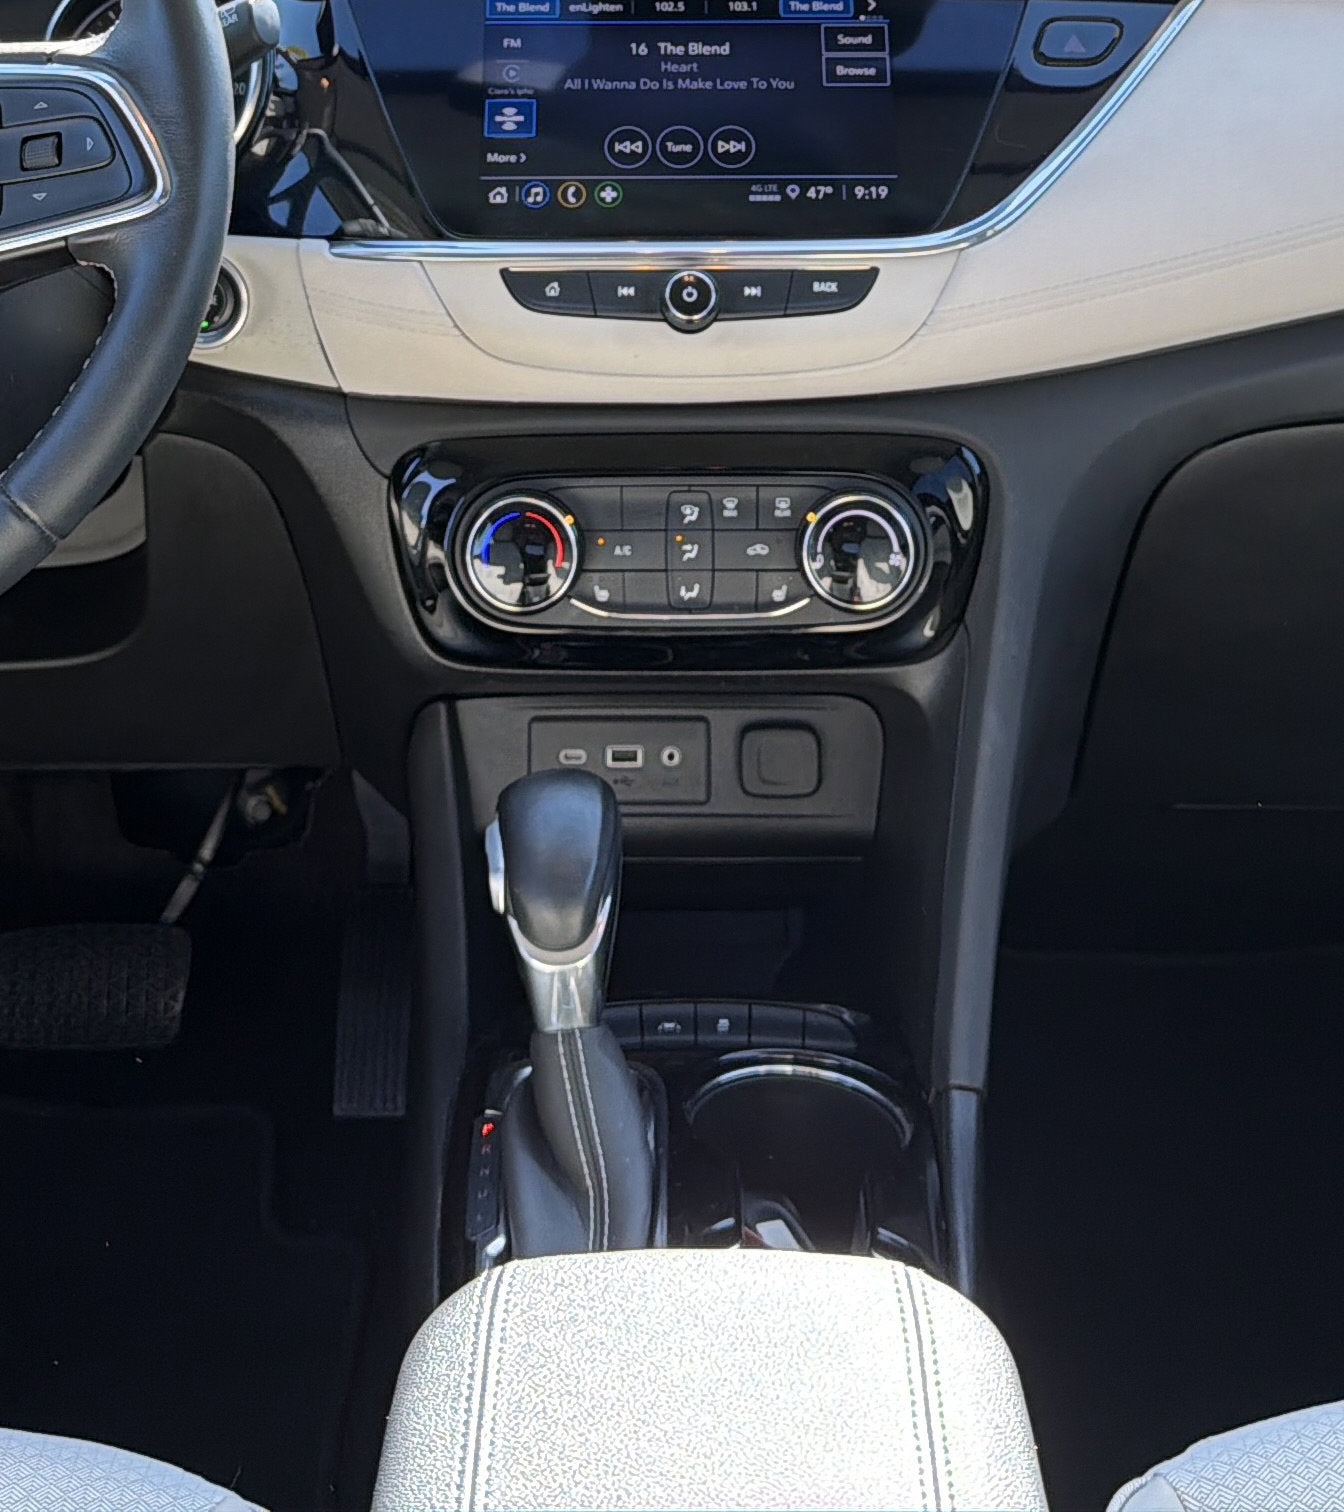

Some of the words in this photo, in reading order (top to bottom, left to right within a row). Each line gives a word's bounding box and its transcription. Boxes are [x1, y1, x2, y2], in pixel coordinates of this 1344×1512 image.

[495, 2, 516, 12] The
[518, 2, 550, 12] Blend
[568, 2, 624, 14] enLighten
[654, 1, 686, 12] 102.5
[728, 1, 758, 12] 103.1
[789, 1, 810, 11] The
[811, 0, 844, 11] Blend
[502, 38, 522, 48] FM
[836, 34, 873, 45] Sound
[630, 43, 648, 56] 16
[657, 42, 685, 55] The
[688, 42, 730, 55] Blend
[660, 61, 698, 73] Heart
[836, 65, 877, 76] Browse
[564, 79, 581, 90] All
[585, 79, 589, 90] I
[591, 79, 637, 90] Wanna
[639, 79, 659, 90] Do
[662, 79, 674, 90] Is
[677, 78, 714, 90] Make
[716, 78, 748, 90] Love
[750, 78, 768, 89] To
[769, 78, 795, 89] You
[665, 142, 693, 153] Tune
[486, 153, 518, 163] More
[751, 184, 763, 192] 4G
[764, 184, 778, 192] LTE
[806, 185, 834, 200] 47°
[854, 185, 889, 200] 9:19
[812, 281, 838, 293] BACK
[613, 545, 632, 556] A/C
